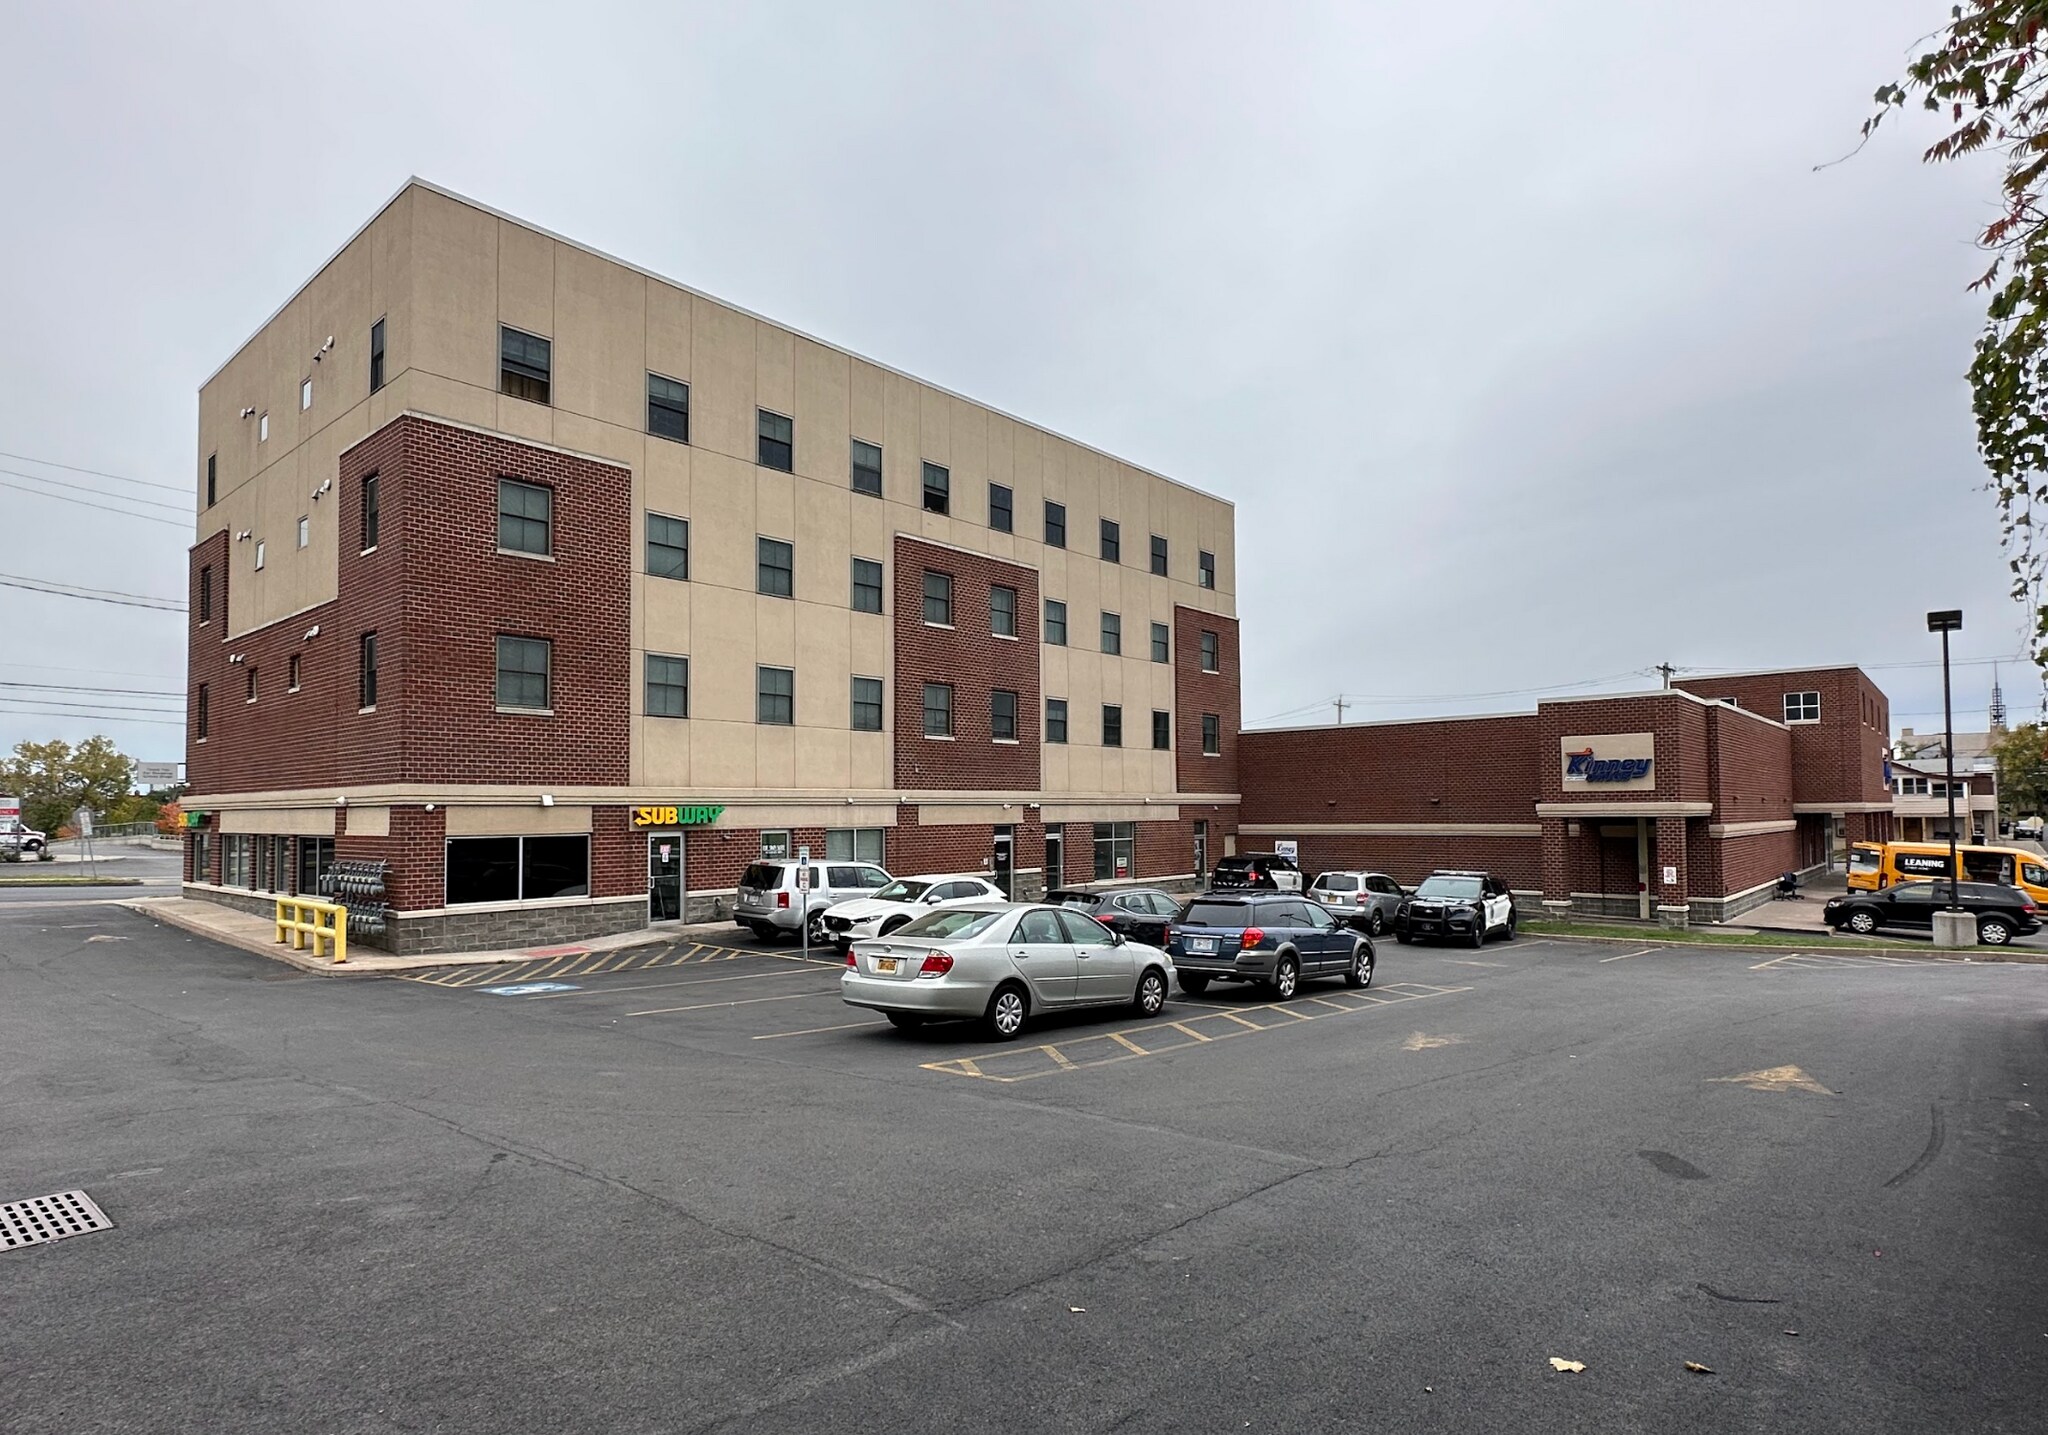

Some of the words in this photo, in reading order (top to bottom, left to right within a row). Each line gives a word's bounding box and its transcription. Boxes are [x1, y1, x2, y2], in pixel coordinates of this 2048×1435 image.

[1565, 755, 1653, 779] Kinney
[634, 805, 725, 826] SUBWAY
[1904, 858, 1945, 868] LEANING
